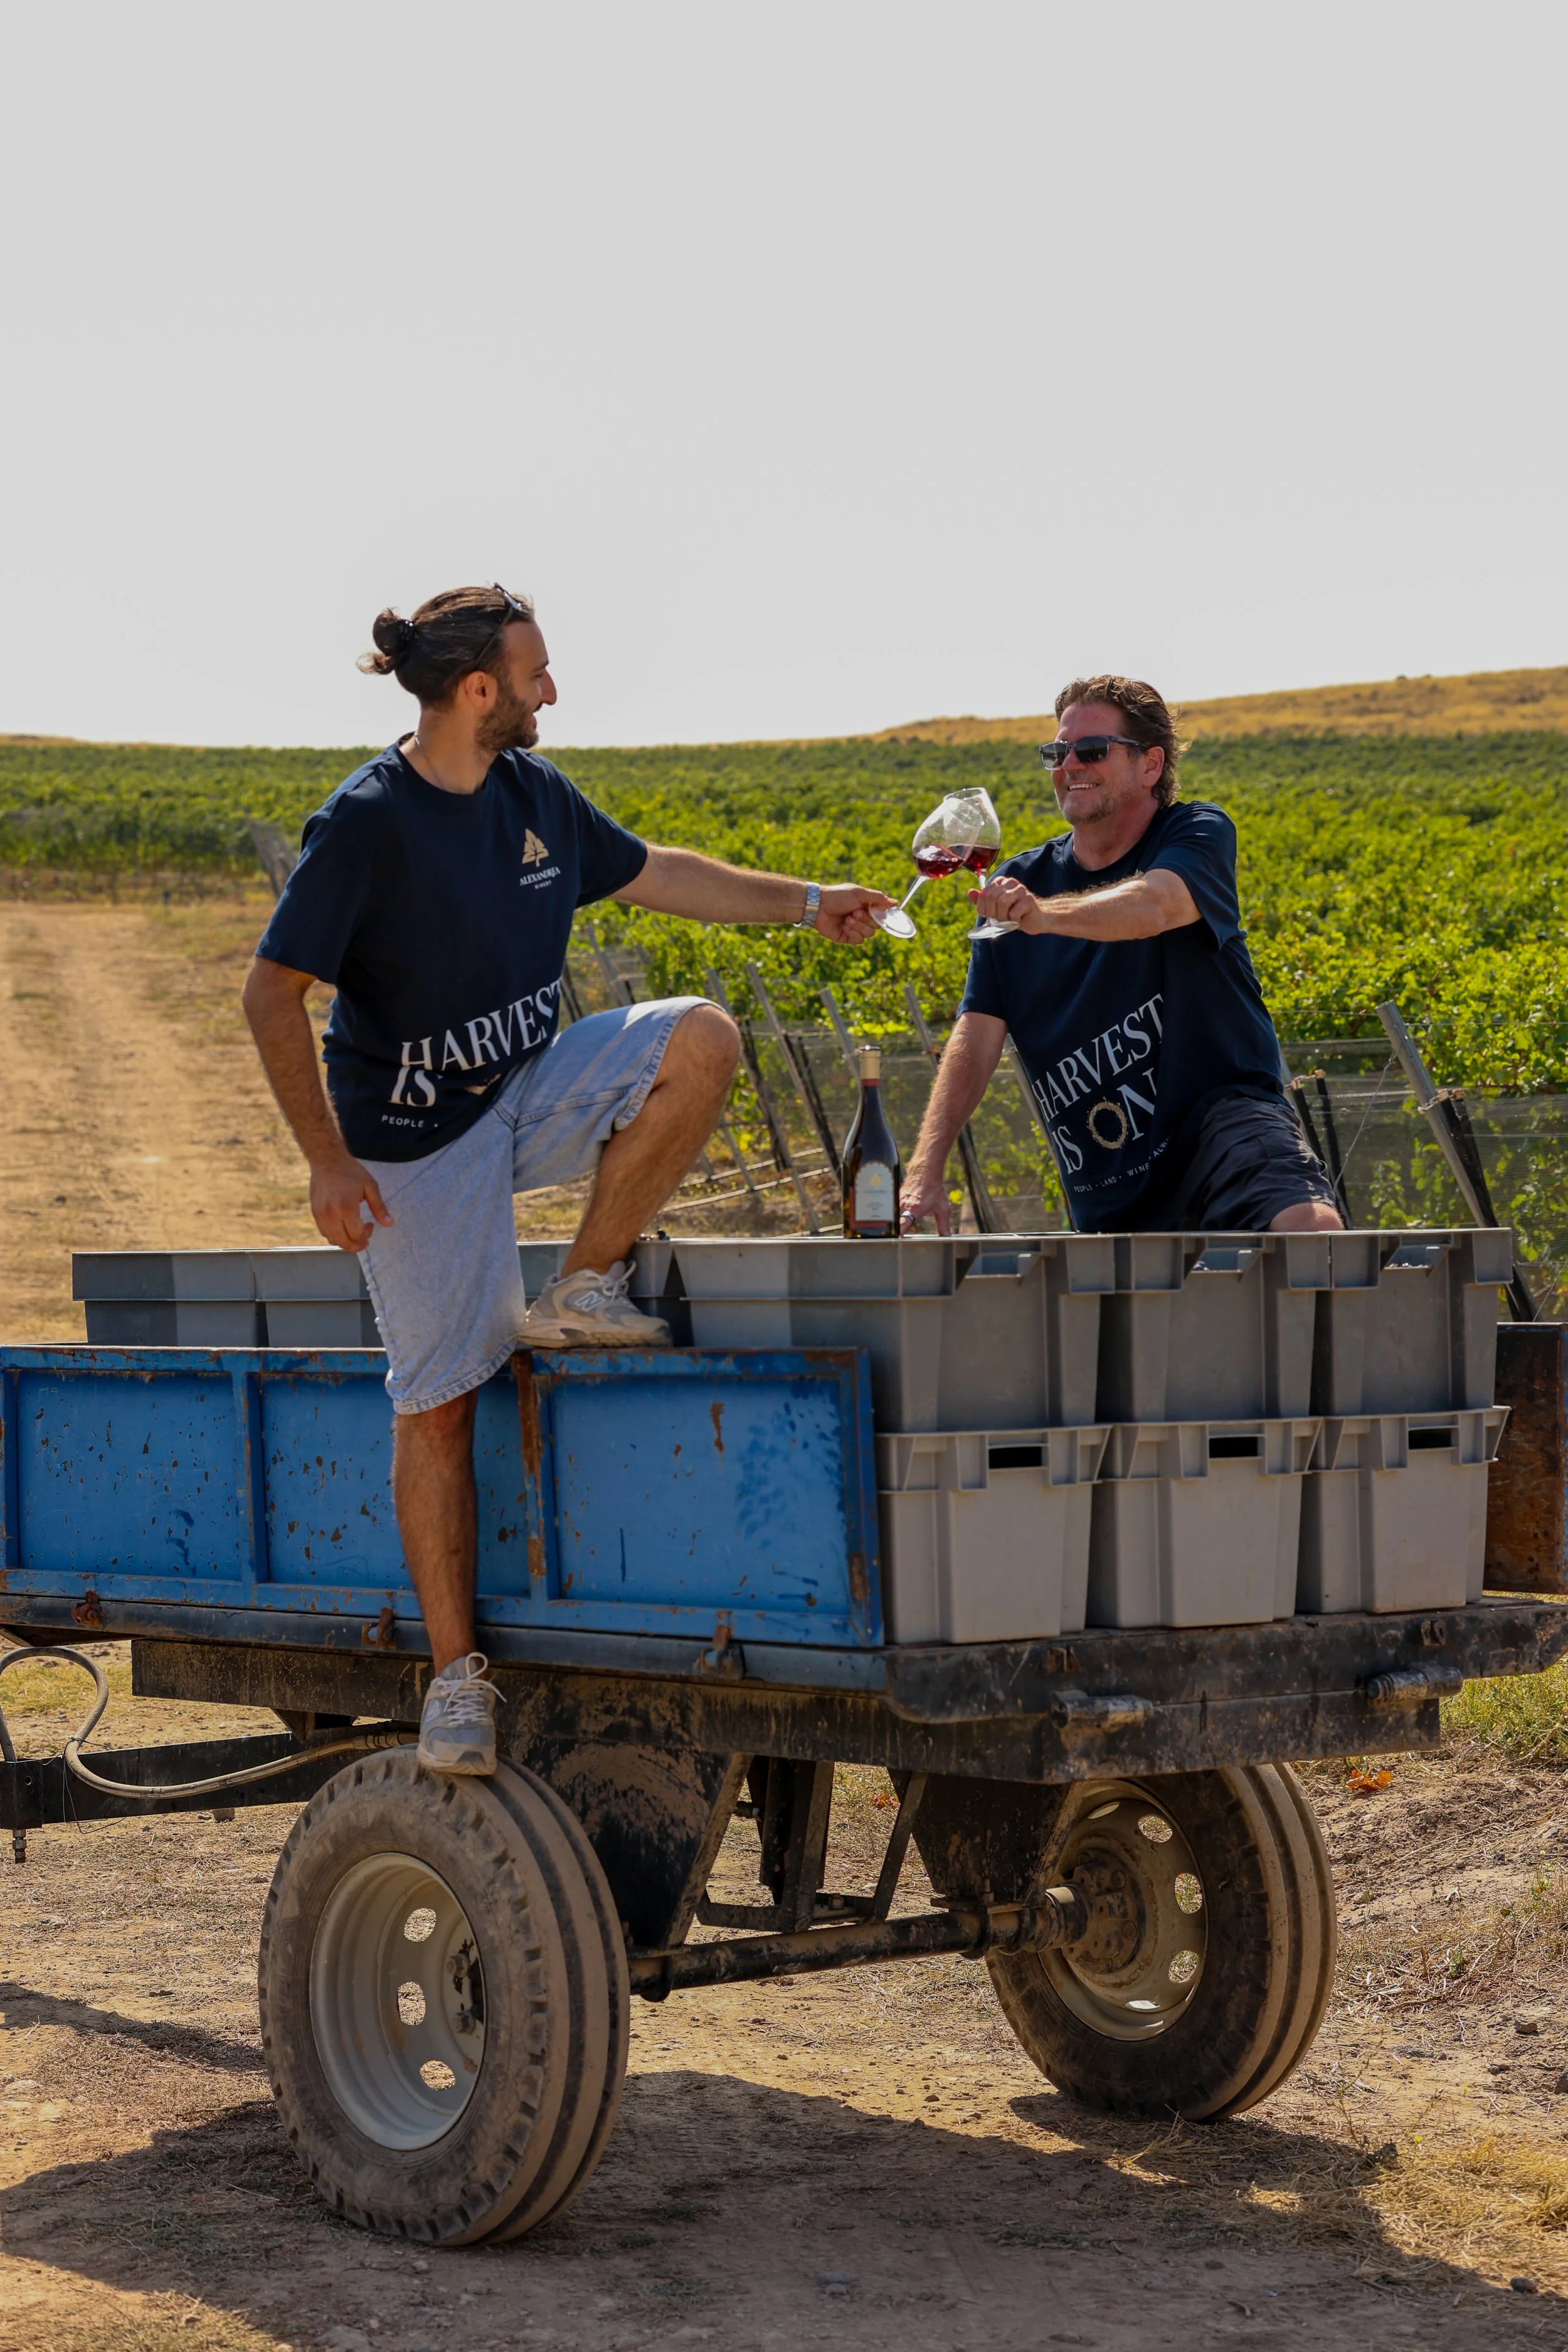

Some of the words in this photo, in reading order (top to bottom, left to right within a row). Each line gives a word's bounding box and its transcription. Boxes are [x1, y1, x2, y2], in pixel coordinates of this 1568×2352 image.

[1031, 993, 1164, 1123] HARVEST
[388, 1066, 443, 1108] IS
[381, 1114, 424, 1128] PEOPLE
[1051, 1125, 1083, 1174] IS
[1086, 1067, 1157, 1150] ON
[1074, 1184, 1093, 1193] PEOPLE
[1101, 1176, 1117, 1188] LAND
